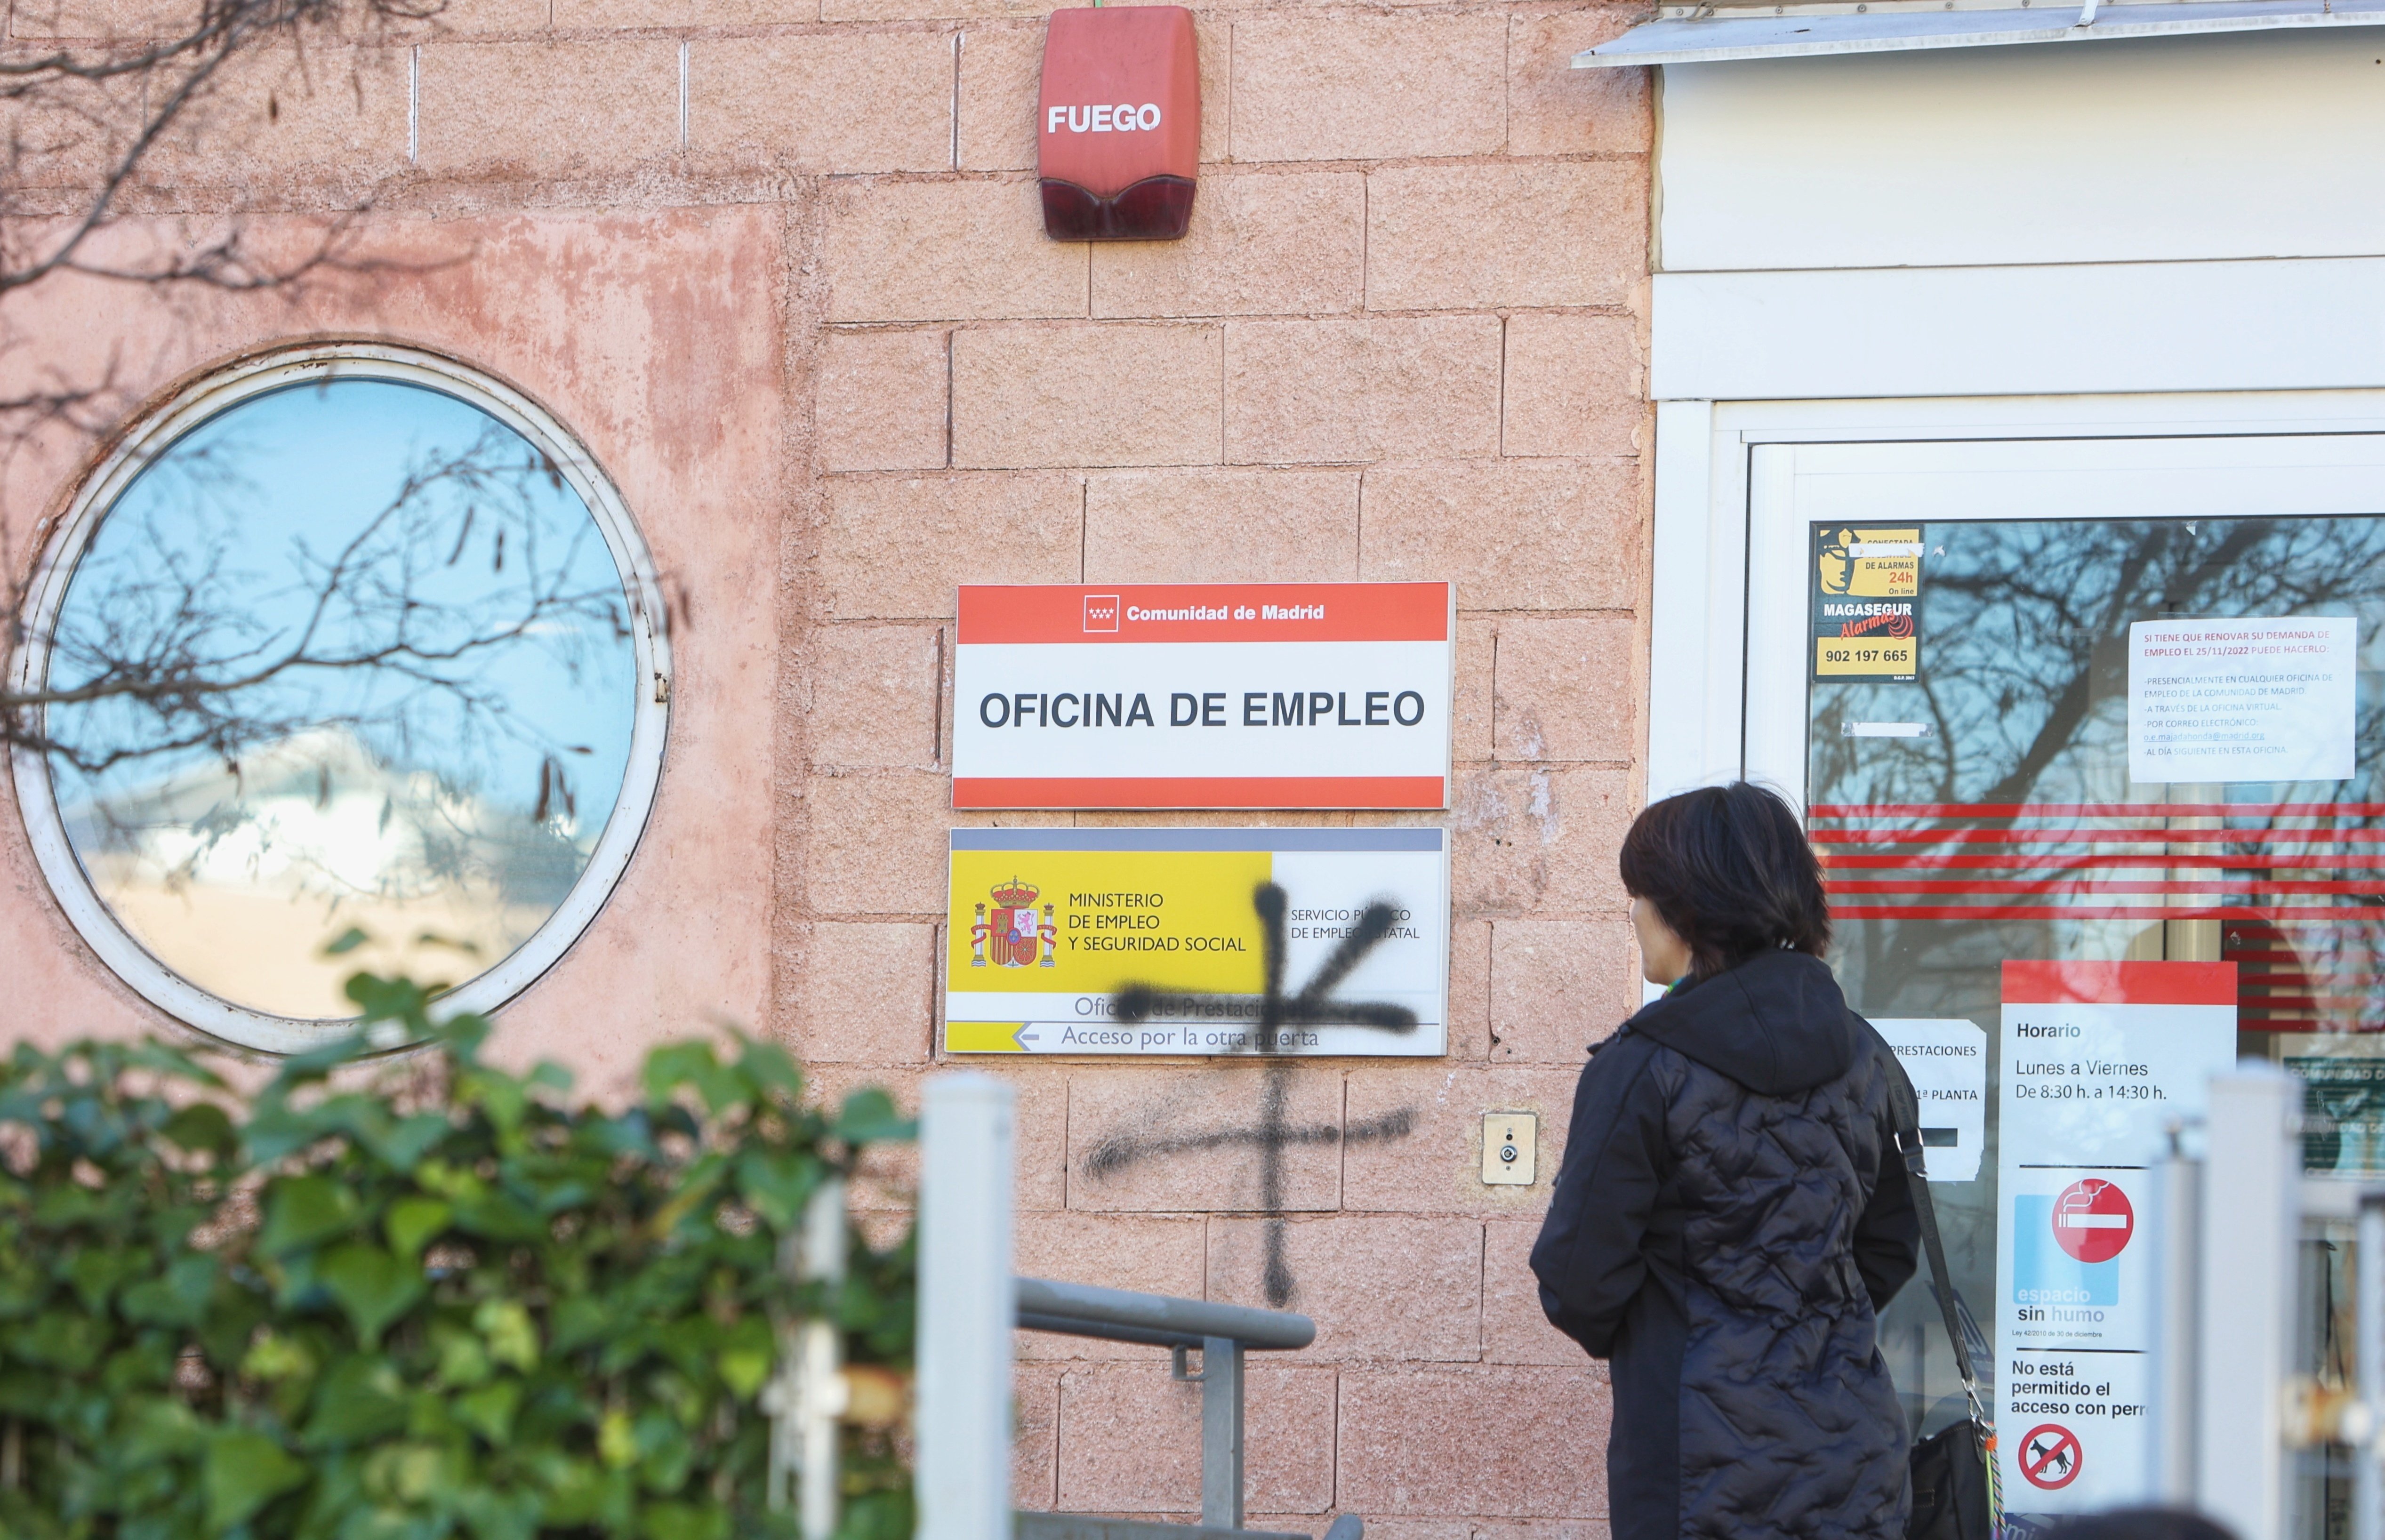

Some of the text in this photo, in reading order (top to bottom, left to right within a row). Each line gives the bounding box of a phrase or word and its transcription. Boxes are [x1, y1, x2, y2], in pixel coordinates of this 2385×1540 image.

[1048, 103, 1161, 133] FUEGO
[1865, 561, 1914, 569] DE ALARMAS
[1889, 571, 1913, 583] 24h
[1127, 604, 1325, 621] Comunidad de Madrid
[1824, 603, 1912, 616] MAGASEGUR
[1841, 610, 1895, 641] Alarmas
[2144, 634, 2152, 642] SI
[2154, 634, 2180, 642] TIENE
[2182, 634, 2202, 642] QUE
[2205, 633, 2249, 641] RENOVAR
[2252, 632, 2263, 640] SU
[2266, 631, 2315, 639] DEMANDA
[1826, 650, 1907, 662] 902 197 665
[2144, 645, 2329, 657] EMPLEO EL 25/11/2022 PUEDE HACERLO:
[2238, 675, 2284, 683] CUALQUIER
[2204, 689, 2256, 697] COMUNIDAD
[980, 690, 1425, 728] OFICINA DE EMPLEO
[2155, 704, 2185, 712] TRAVÉS
[2158, 746, 2172, 755] DÍA
[1069, 893, 1164, 907] MINISTERIO
[1069, 914, 1091, 929] DE
[1096, 915, 1160, 929] EMPLEO
[1292, 910, 1349, 921] SERVICIO
[1292, 928, 1309, 938] DE
[1314, 928, 1362, 938] EMPLEO
[1068, 936, 1246, 951] Y SEGURIDAD SOCIAL
[1075, 997, 1148, 1016] Ofic
[1153, 998, 1175, 1016] de
[2017, 1023, 2080, 1038] Horario
[1061, 1026, 1319, 1051] Acceso por la otra puerta
[1890, 1046, 1976, 1056] PRESTACIONES
[2016, 1060, 2148, 1076] Lunes a Viernes
[1932, 1090, 1978, 1100] PLANTA
[2016, 1084, 2167, 1100] De 8:30 h. a 14:30 h.
[2017, 1286, 2091, 1304] espacio
[2018, 1305, 2104, 1323] sin humo
[2012, 1360, 2074, 1376] No está
[2012, 1381, 2110, 1397] permitido el
[2011, 1402, 2148, 1419] acceso con perr
